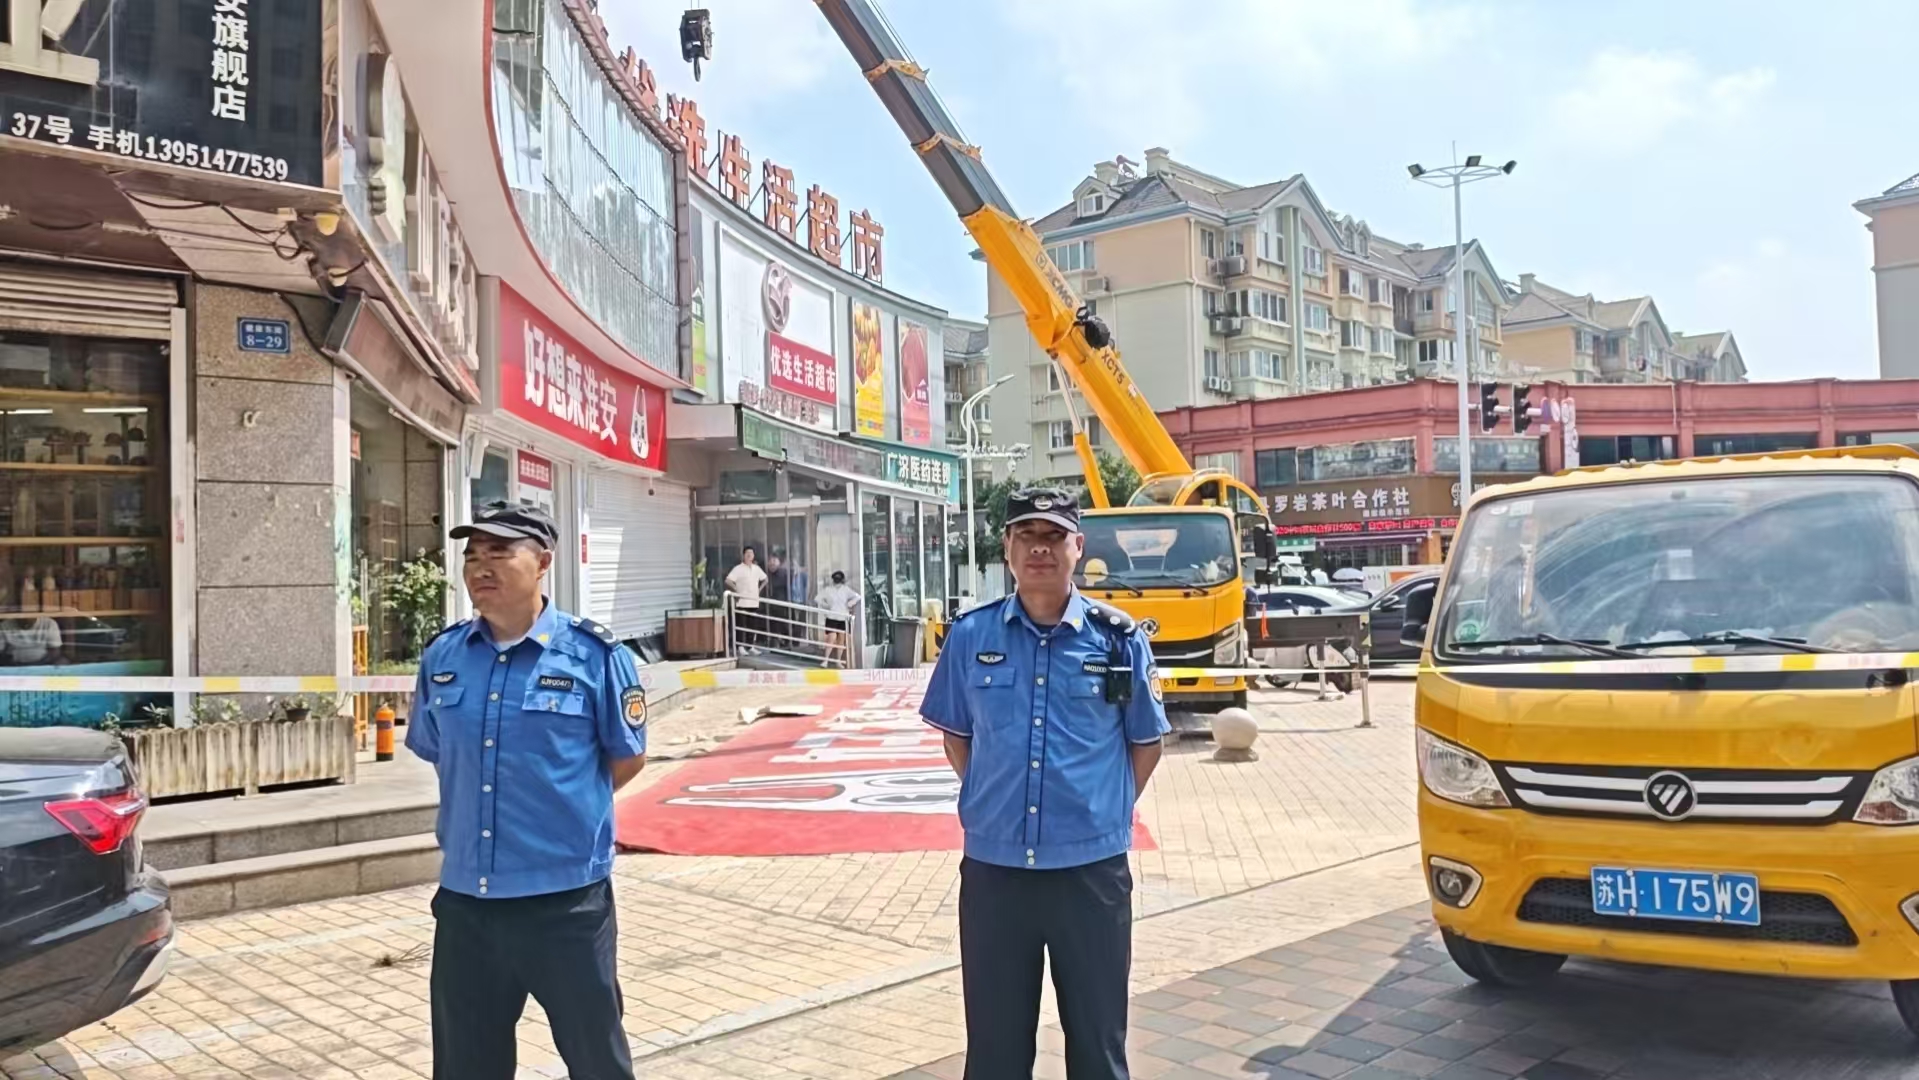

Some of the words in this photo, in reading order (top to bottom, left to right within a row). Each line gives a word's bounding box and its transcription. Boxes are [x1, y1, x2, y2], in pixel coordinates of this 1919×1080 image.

[245, 334, 283, 348] 8-29
[524, 319, 618, 446] 好想来淮安
[771, 345, 836, 394] 优选生活超市
[887, 452, 951, 485] 广济医药连锁
